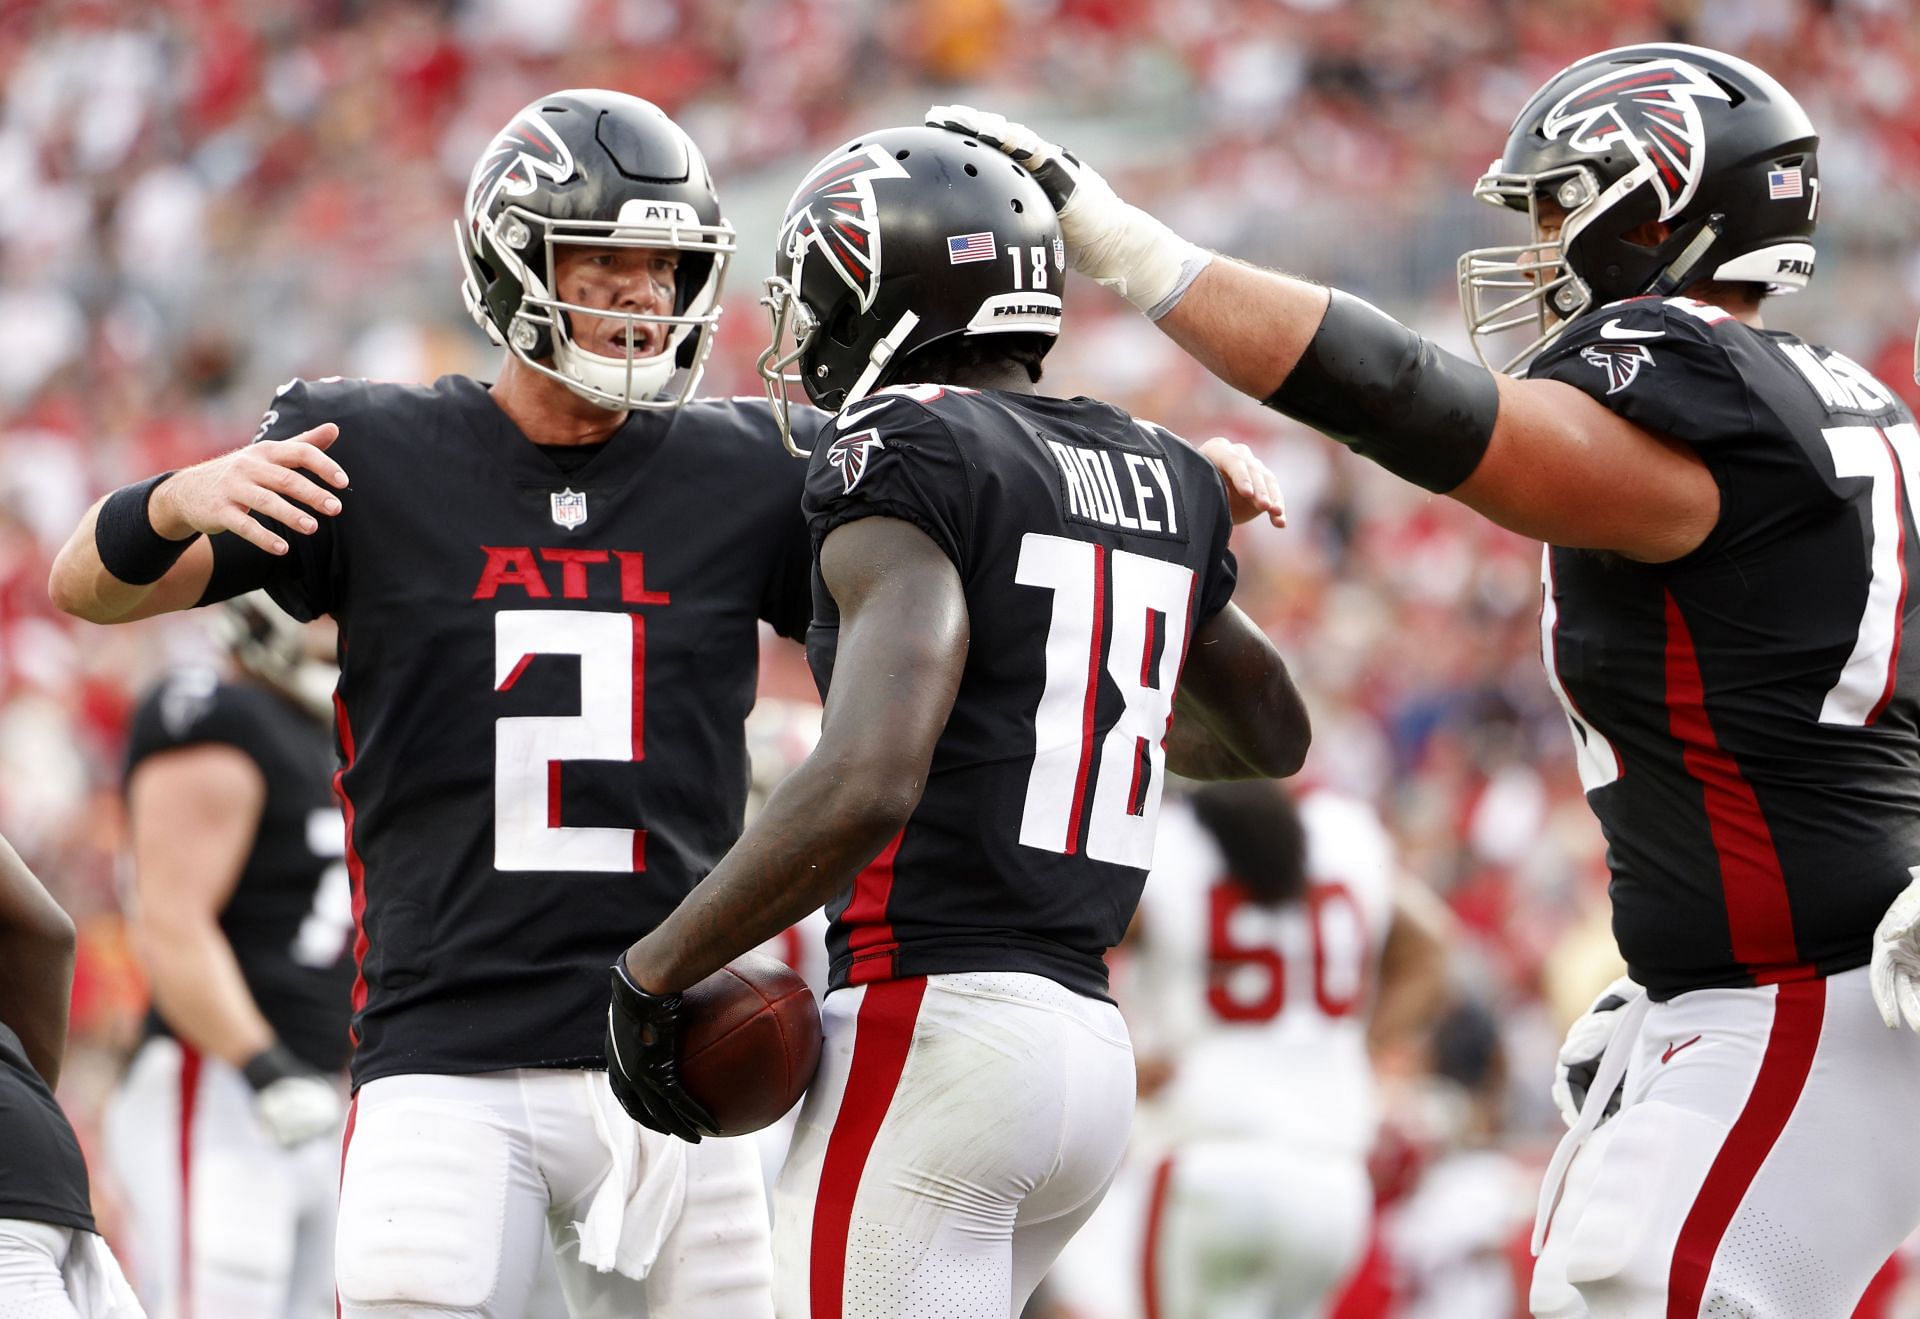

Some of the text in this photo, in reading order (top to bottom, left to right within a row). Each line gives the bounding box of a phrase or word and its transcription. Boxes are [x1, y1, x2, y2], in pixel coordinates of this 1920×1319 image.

[645, 206, 684, 221] ATL
[1007, 246, 1047, 290] 18
[1776, 259, 1814, 279] FAL
[1047, 439, 1178, 534] RIDLEY
[472, 545, 671, 605] ATL
[1014, 532, 1197, 871] 18
[494, 609, 647, 873] 2
[1207, 880, 1374, 1023] 50
